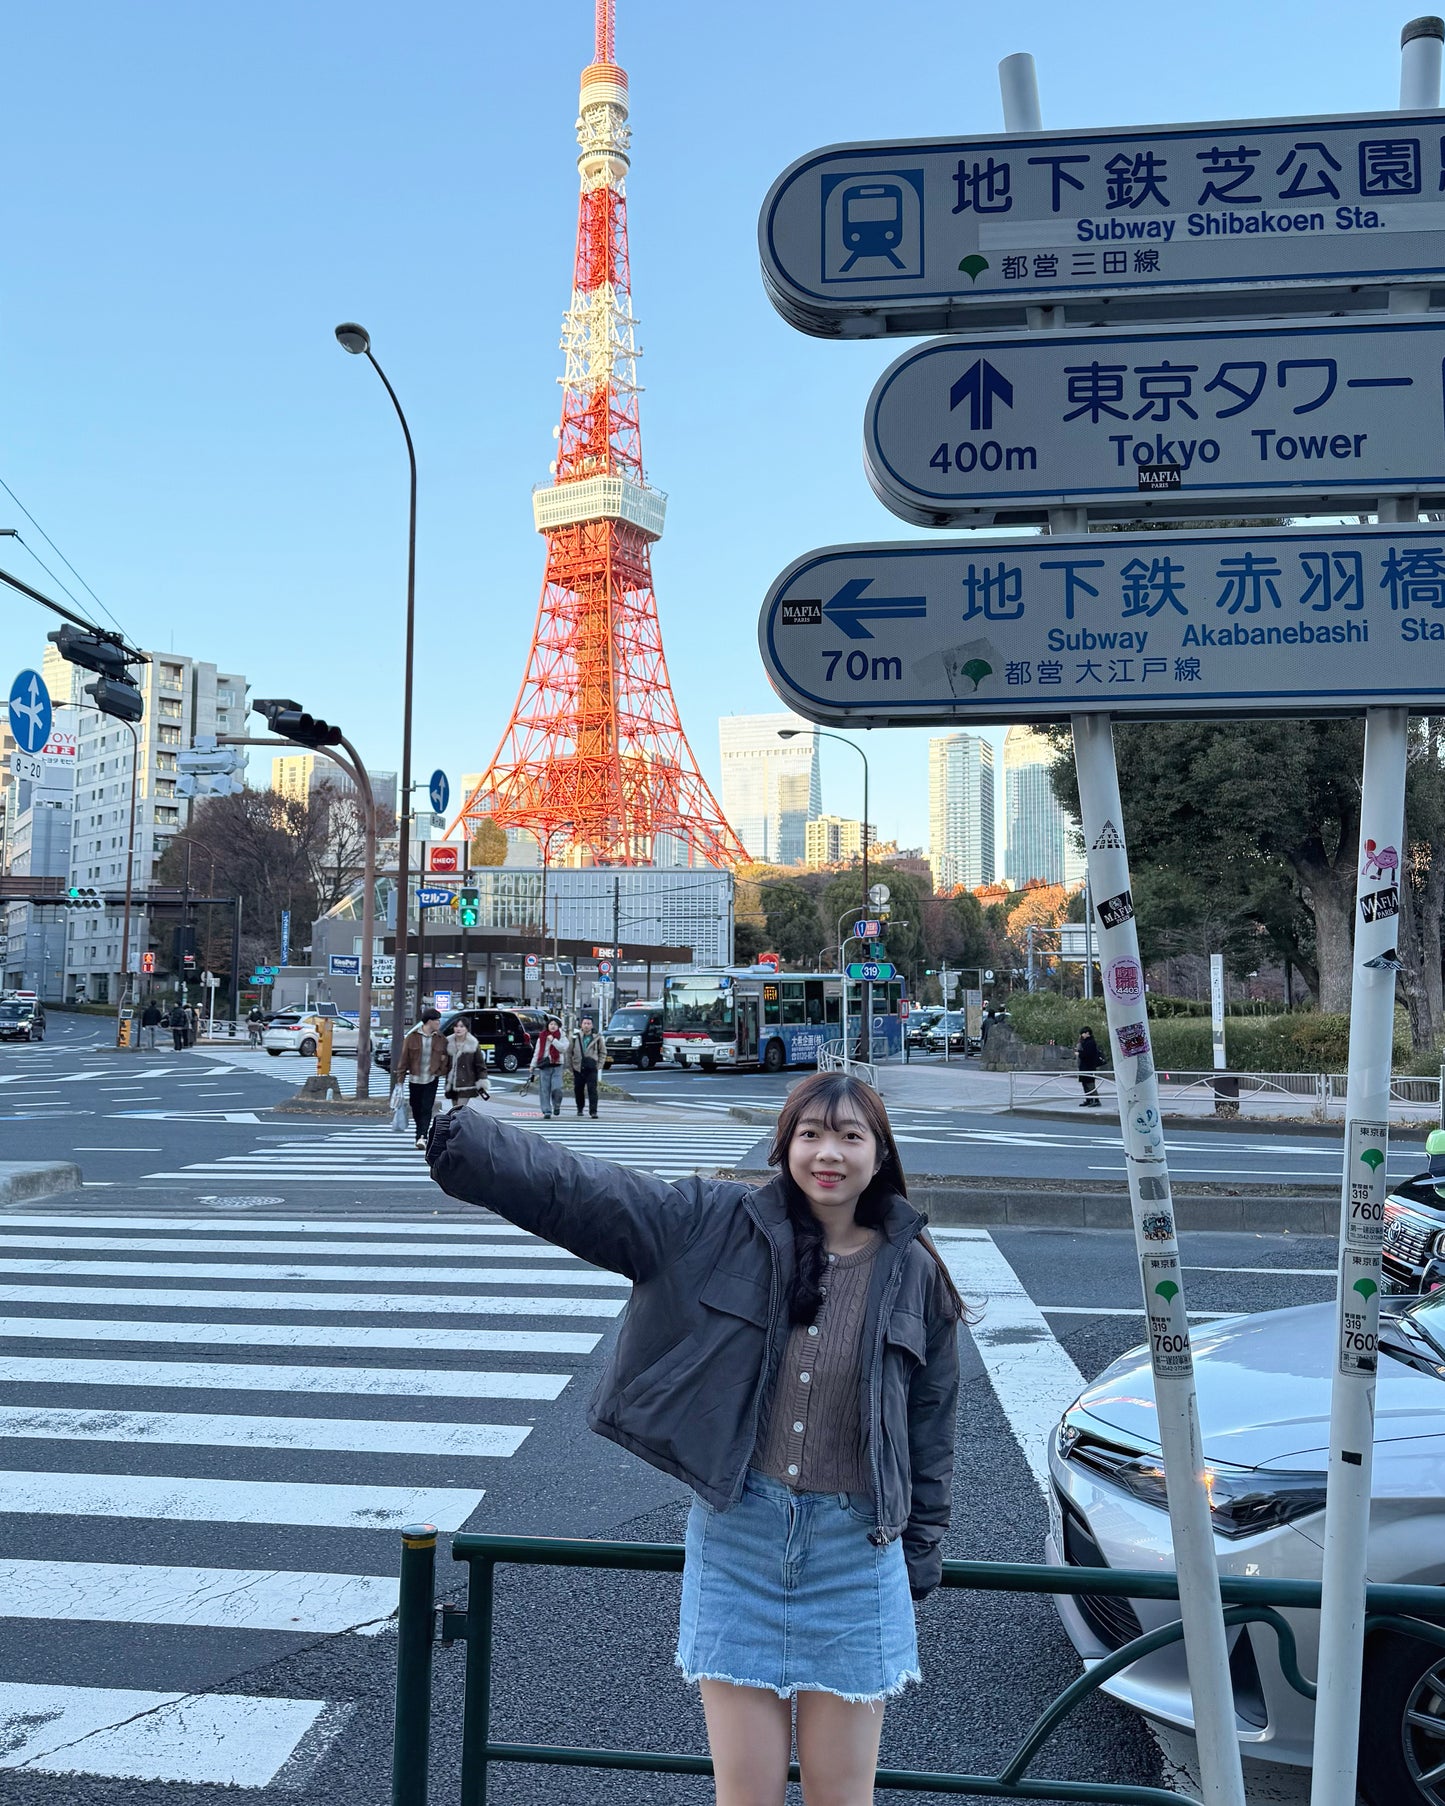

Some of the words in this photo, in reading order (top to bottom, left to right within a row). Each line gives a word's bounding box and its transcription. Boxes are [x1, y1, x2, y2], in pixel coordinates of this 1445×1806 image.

[1077, 218, 1175, 243] Subway
[1188, 210, 1325, 237] Shibakoen
[1335, 206, 1386, 231] Sta.
[1063, 358, 1413, 424] 東京タワー
[1109, 433, 1220, 470] Tokyo
[1251, 428, 1367, 460] Tower
[929, 441, 1037, 474] 400m
[1140, 471, 1180, 482] MAFIA
[783, 606, 820, 617] MAFIA
[1048, 628, 1149, 654] Subway
[1182, 619, 1369, 647] Akabanebashi
[822, 650, 902, 681] 70m
[420, 892, 449, 903] セルフ
[1361, 891, 1399, 916] MAFIA
[863, 966, 878, 976] 319
[1352, 1190, 1369, 1199] 319
[1150, 1258, 1178, 1268] 東京都
[1152, 1322, 1168, 1333] 319
[1345, 1319, 1362, 1329] 319
[1153, 1334, 1190, 1352] 7604
